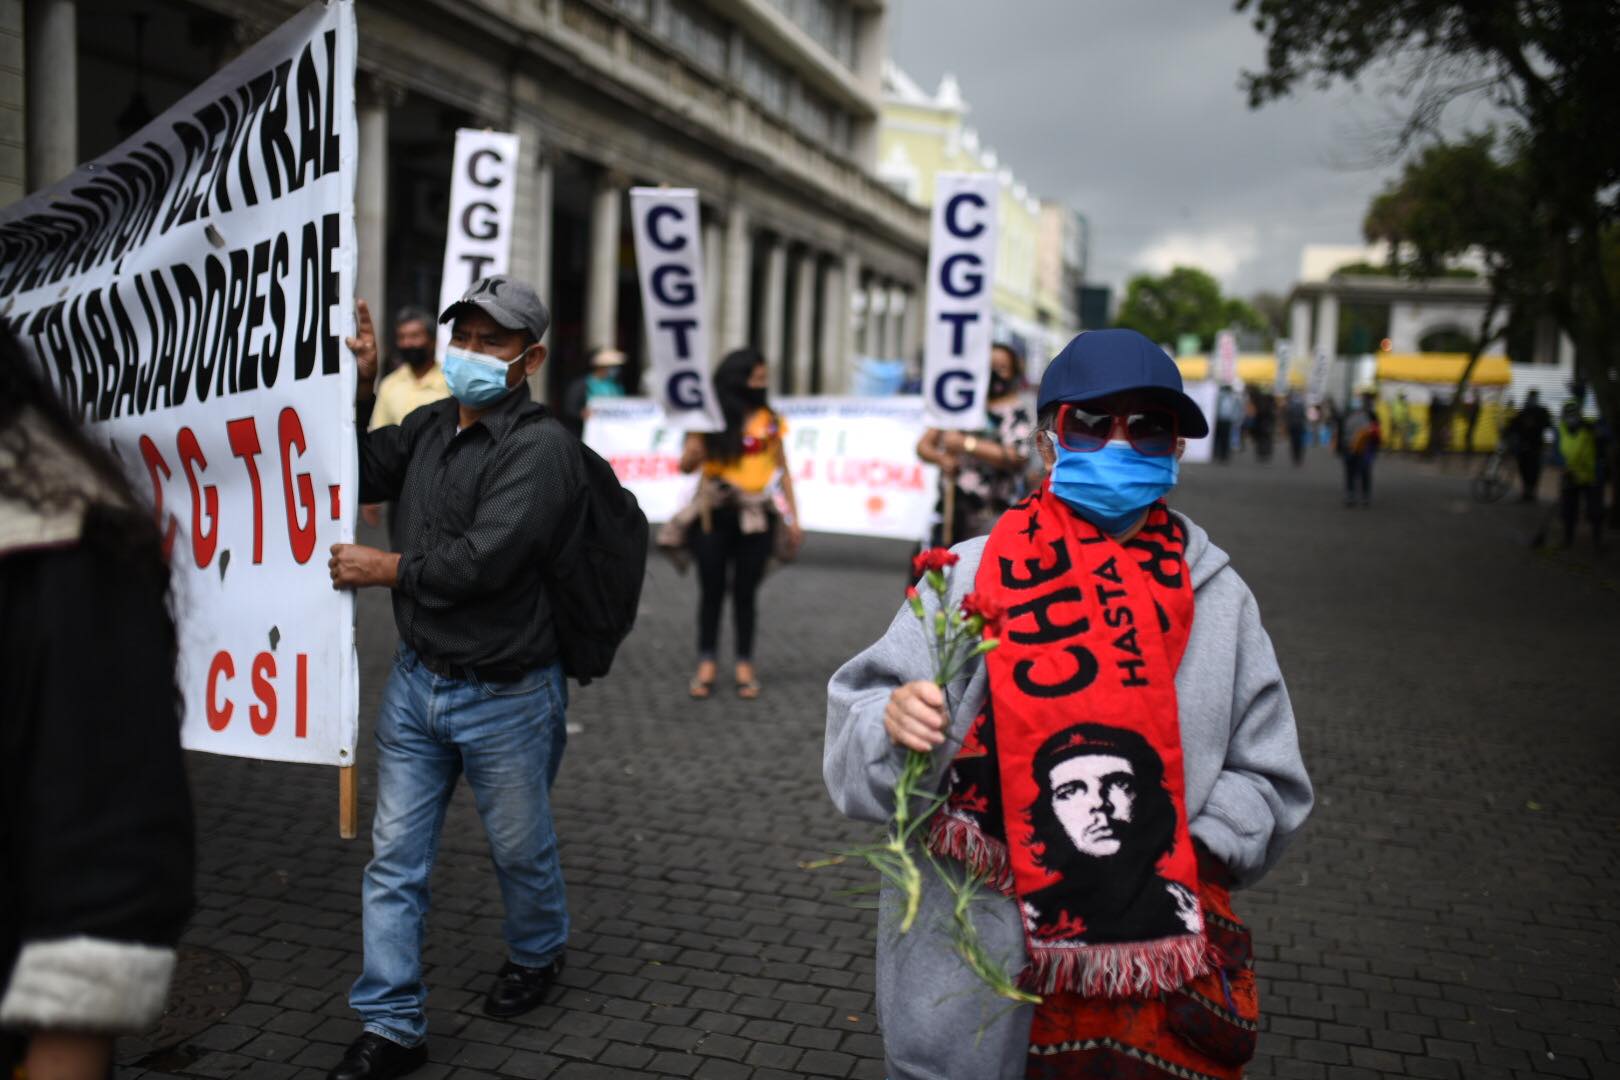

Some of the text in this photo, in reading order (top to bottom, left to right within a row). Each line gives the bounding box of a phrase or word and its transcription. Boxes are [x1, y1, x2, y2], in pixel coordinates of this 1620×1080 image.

[160, 29, 340, 236] CENTRAL
[28, 213, 340, 427] TRABAJADORES DE
[644, 205, 705, 411] CGTG
[933, 193, 987, 413] CGTG
[999, 536, 1099, 699] CHE
[1092, 556, 1150, 688] HASTA
